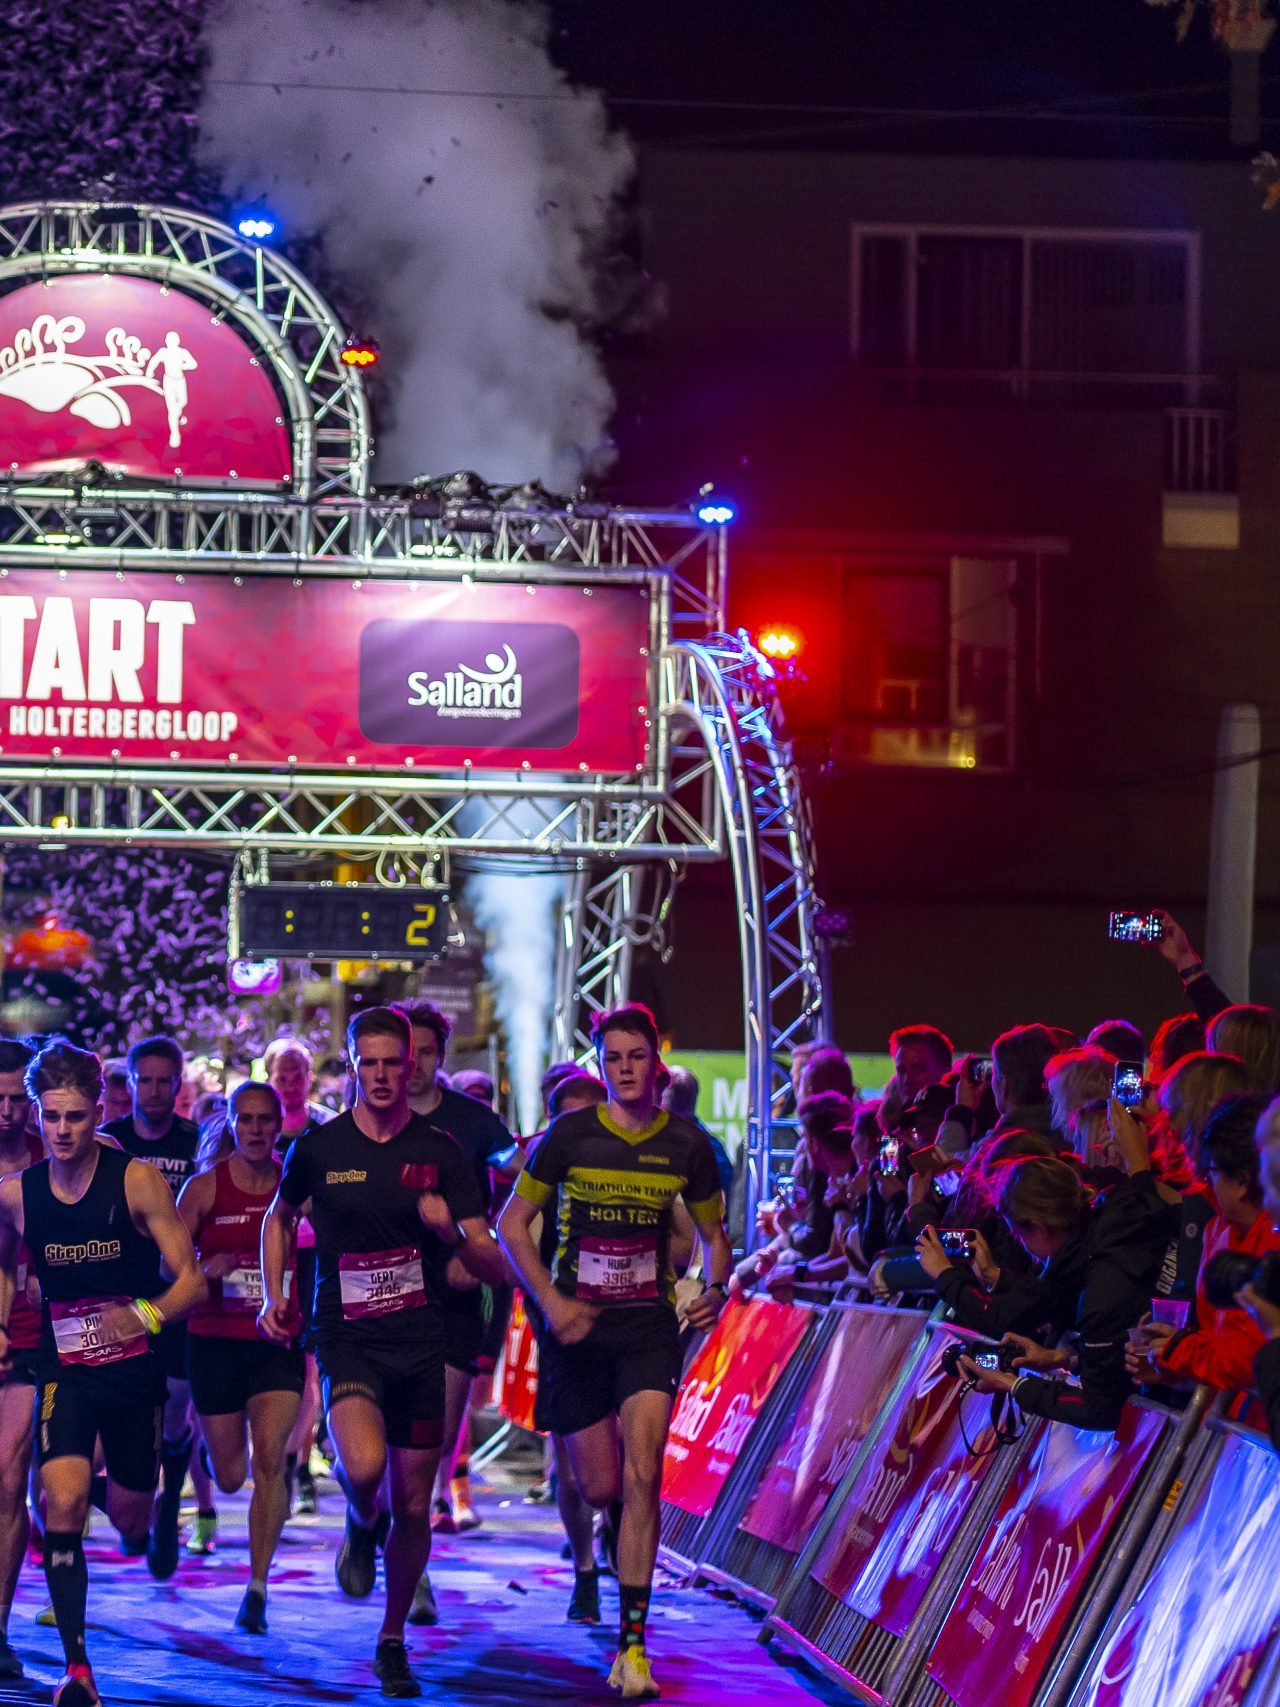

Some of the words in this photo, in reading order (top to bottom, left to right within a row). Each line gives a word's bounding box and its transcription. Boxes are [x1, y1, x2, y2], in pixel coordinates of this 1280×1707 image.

[407, 671, 522, 708] Salland
[9, 705, 239, 743] HOLTERBERGLOOP
[582, 1181, 642, 1195] TRIATHLON
[45, 1243, 86, 1263] Step
[86, 1240, 120, 1258] One
